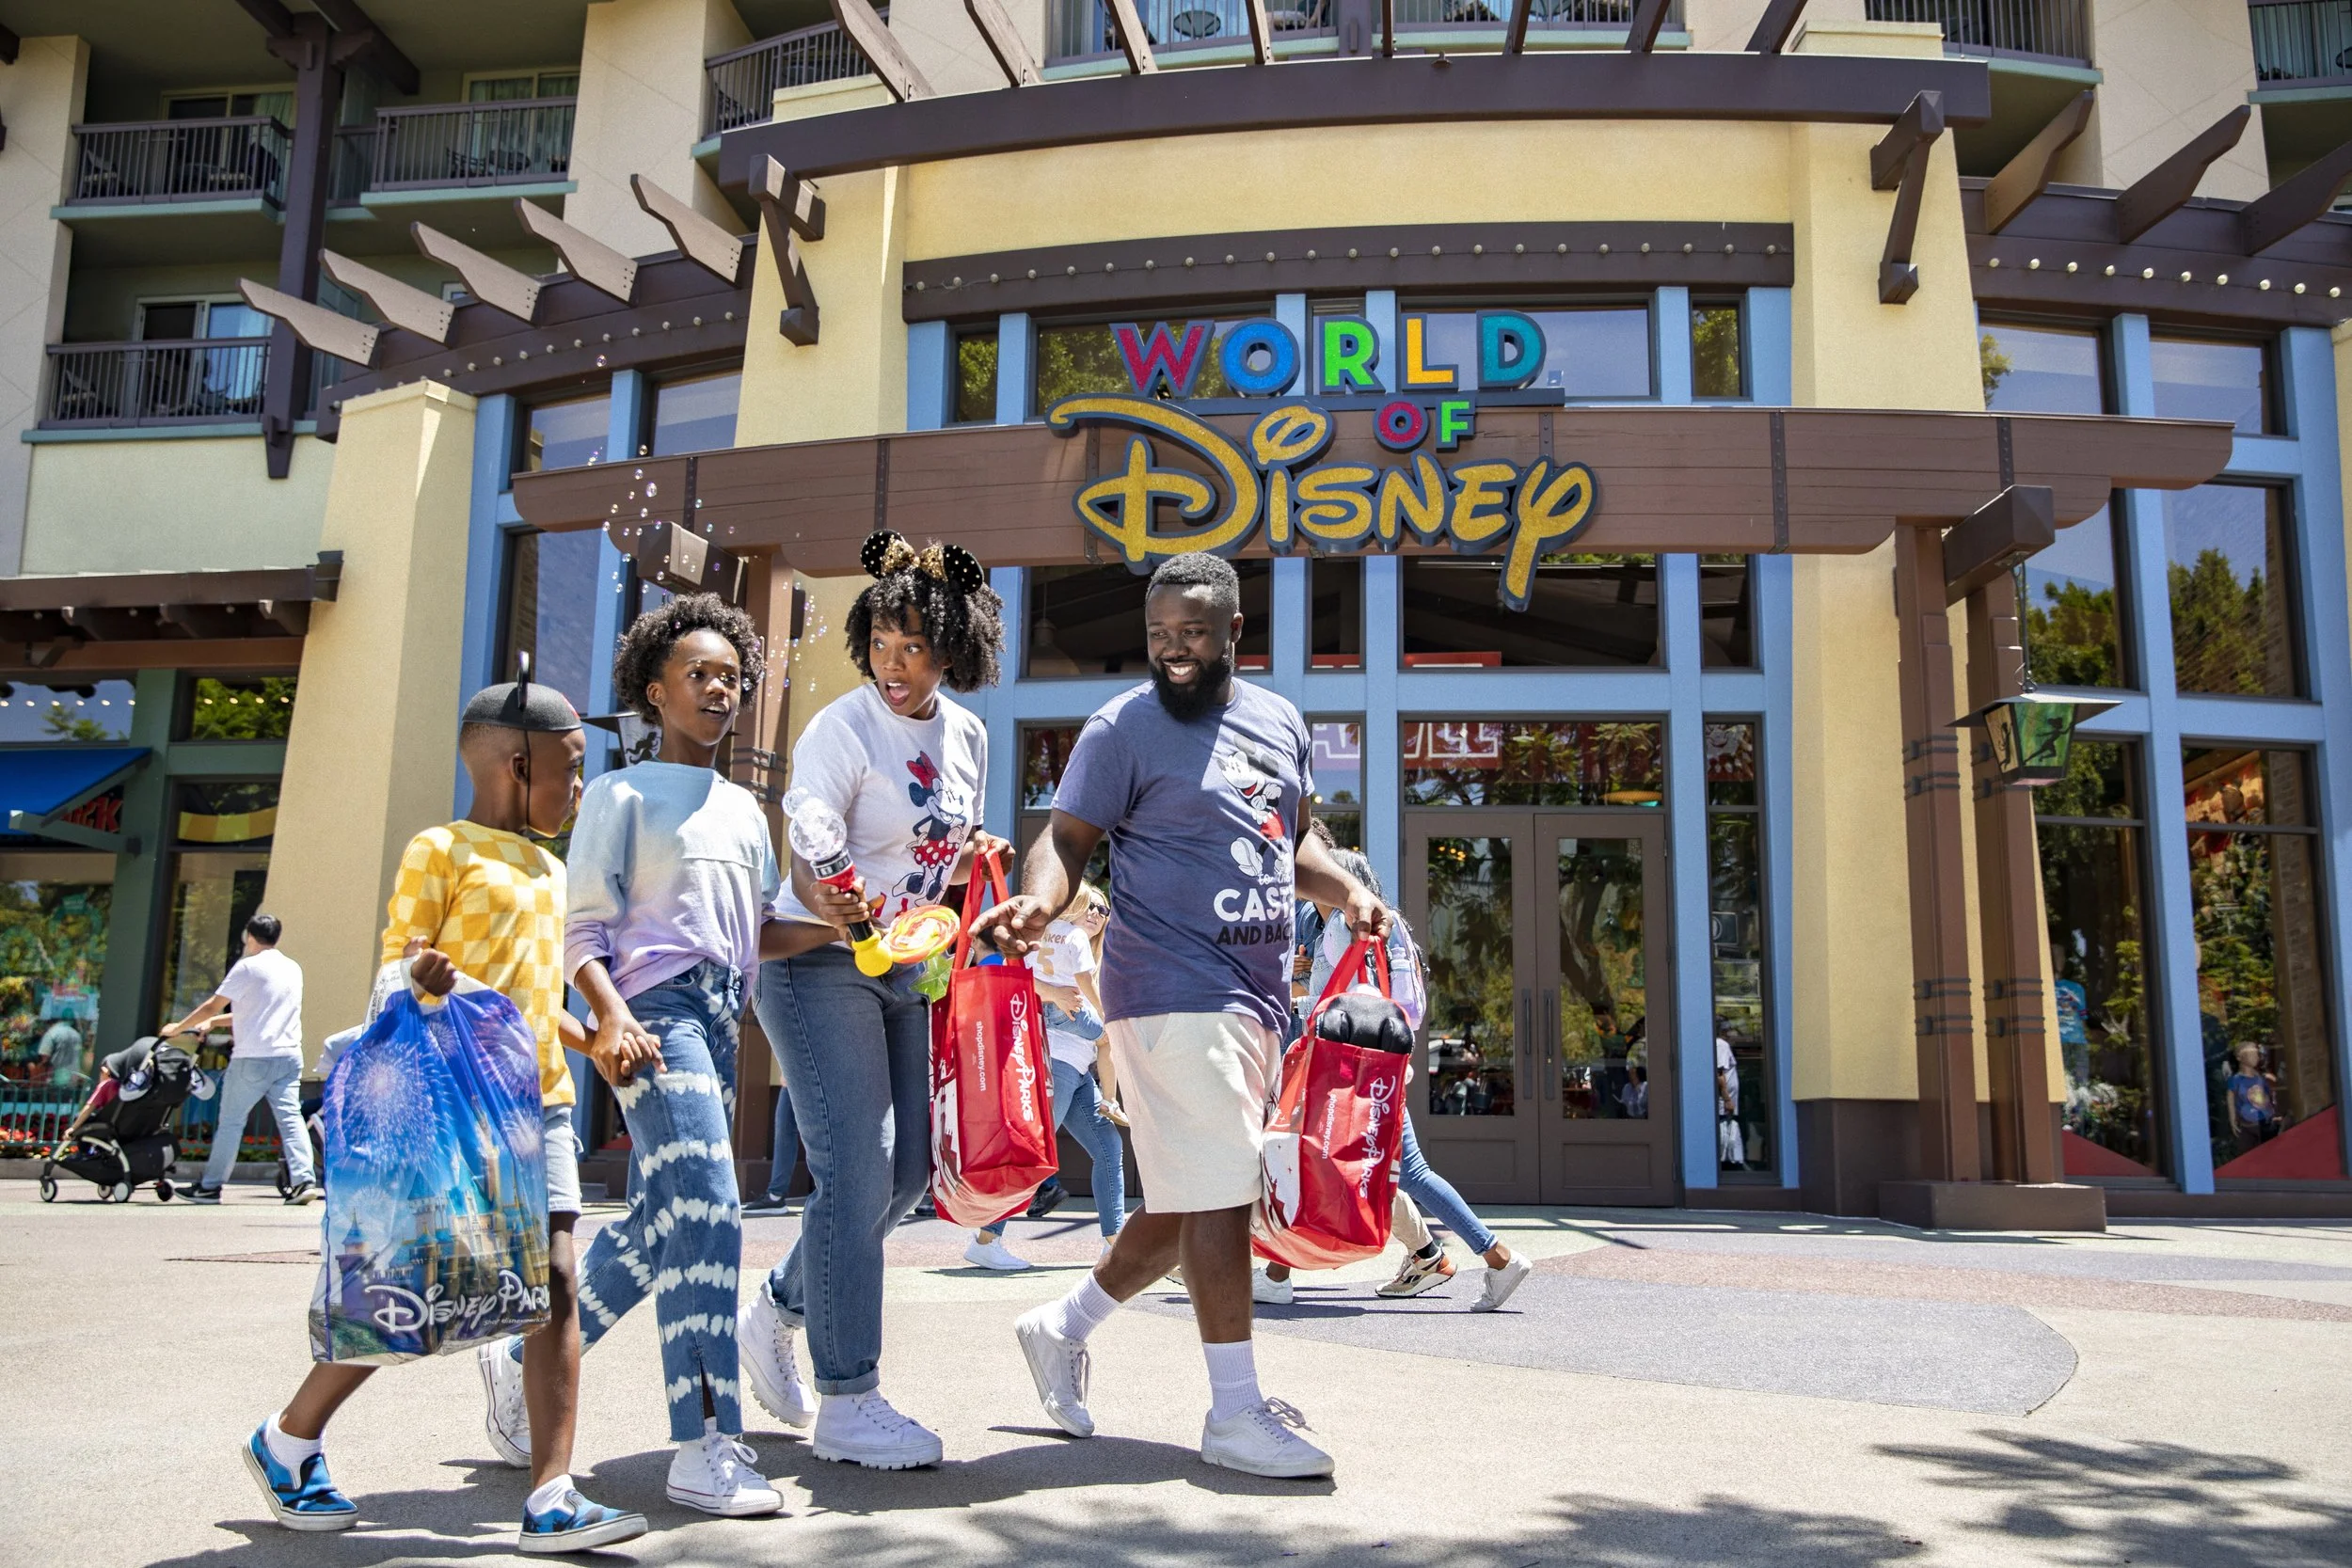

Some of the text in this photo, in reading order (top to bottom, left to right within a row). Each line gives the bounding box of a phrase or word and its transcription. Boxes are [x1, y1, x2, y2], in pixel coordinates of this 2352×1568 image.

[1110, 310, 1548, 400] WORLD
[1374, 396, 1475, 451] OF
[1214, 886, 1293, 922] CAST
[1216, 923, 1292, 945] AND BAC
[975, 1021, 987, 1092] shopdisney.com
[1321, 1093, 1338, 1160] shopdisney.com
